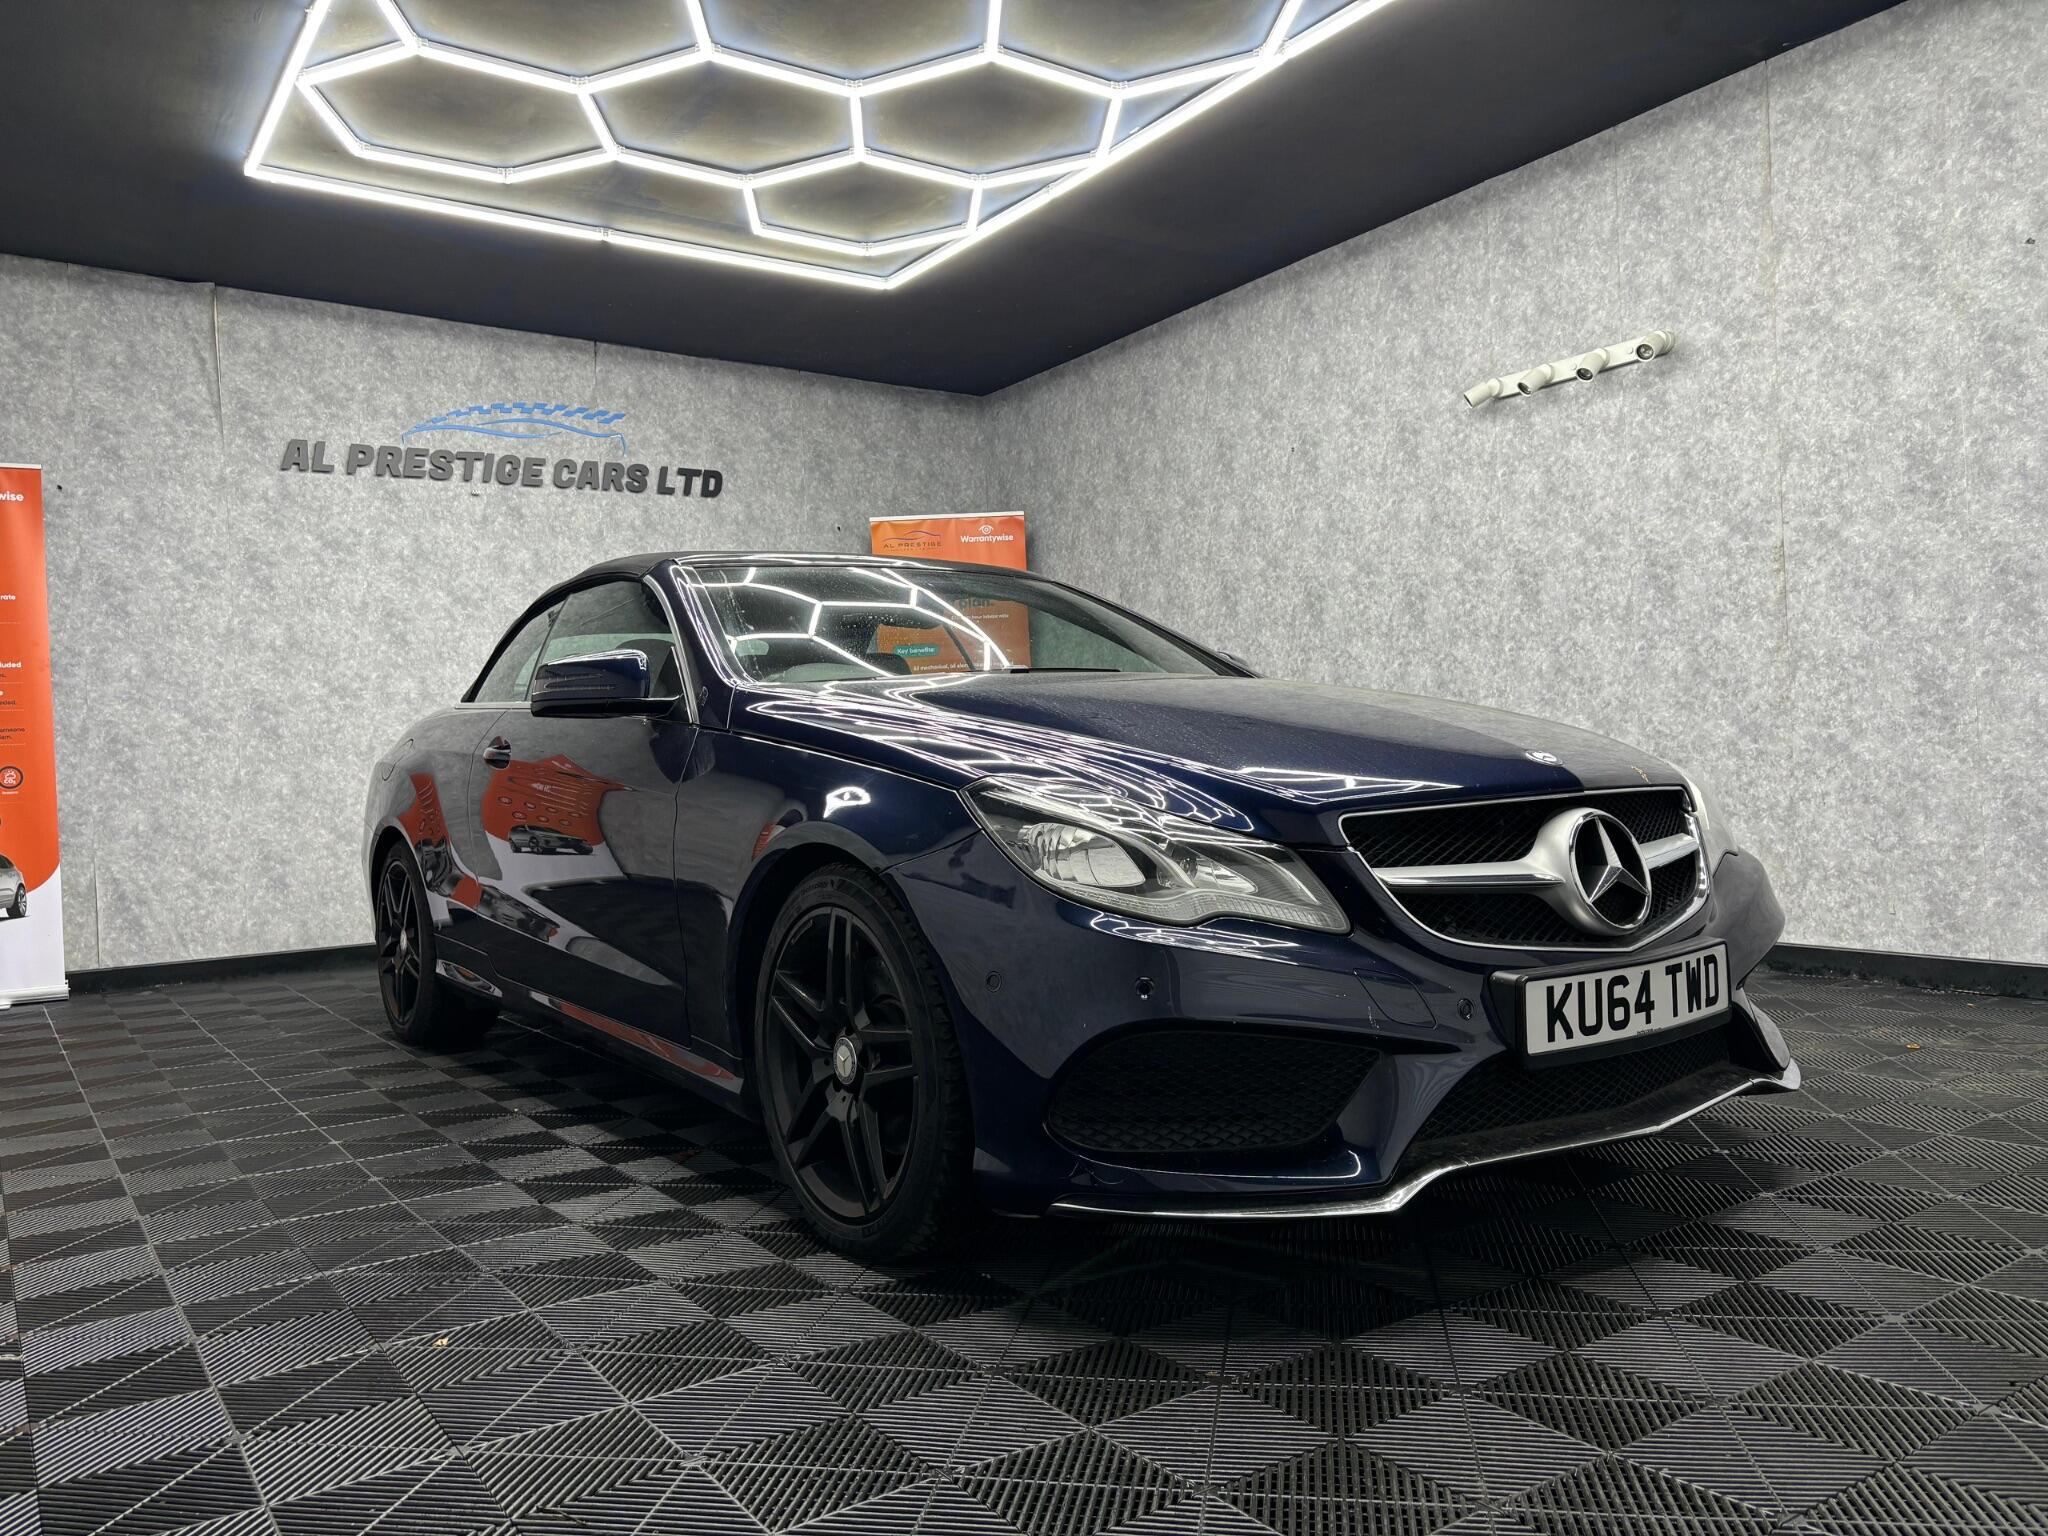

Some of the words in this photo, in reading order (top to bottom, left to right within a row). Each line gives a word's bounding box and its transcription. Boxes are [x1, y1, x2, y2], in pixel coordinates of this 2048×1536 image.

[280, 438, 335, 473] AL
[346, 443, 546, 487] PRESTIGE
[553, 458, 649, 493] CARS
[656, 466, 724, 498] LTD
[960, 533, 1014, 543] Warrantywise
[1546, 969, 1655, 1043] KU64
[1664, 953, 1720, 1018] TWD
